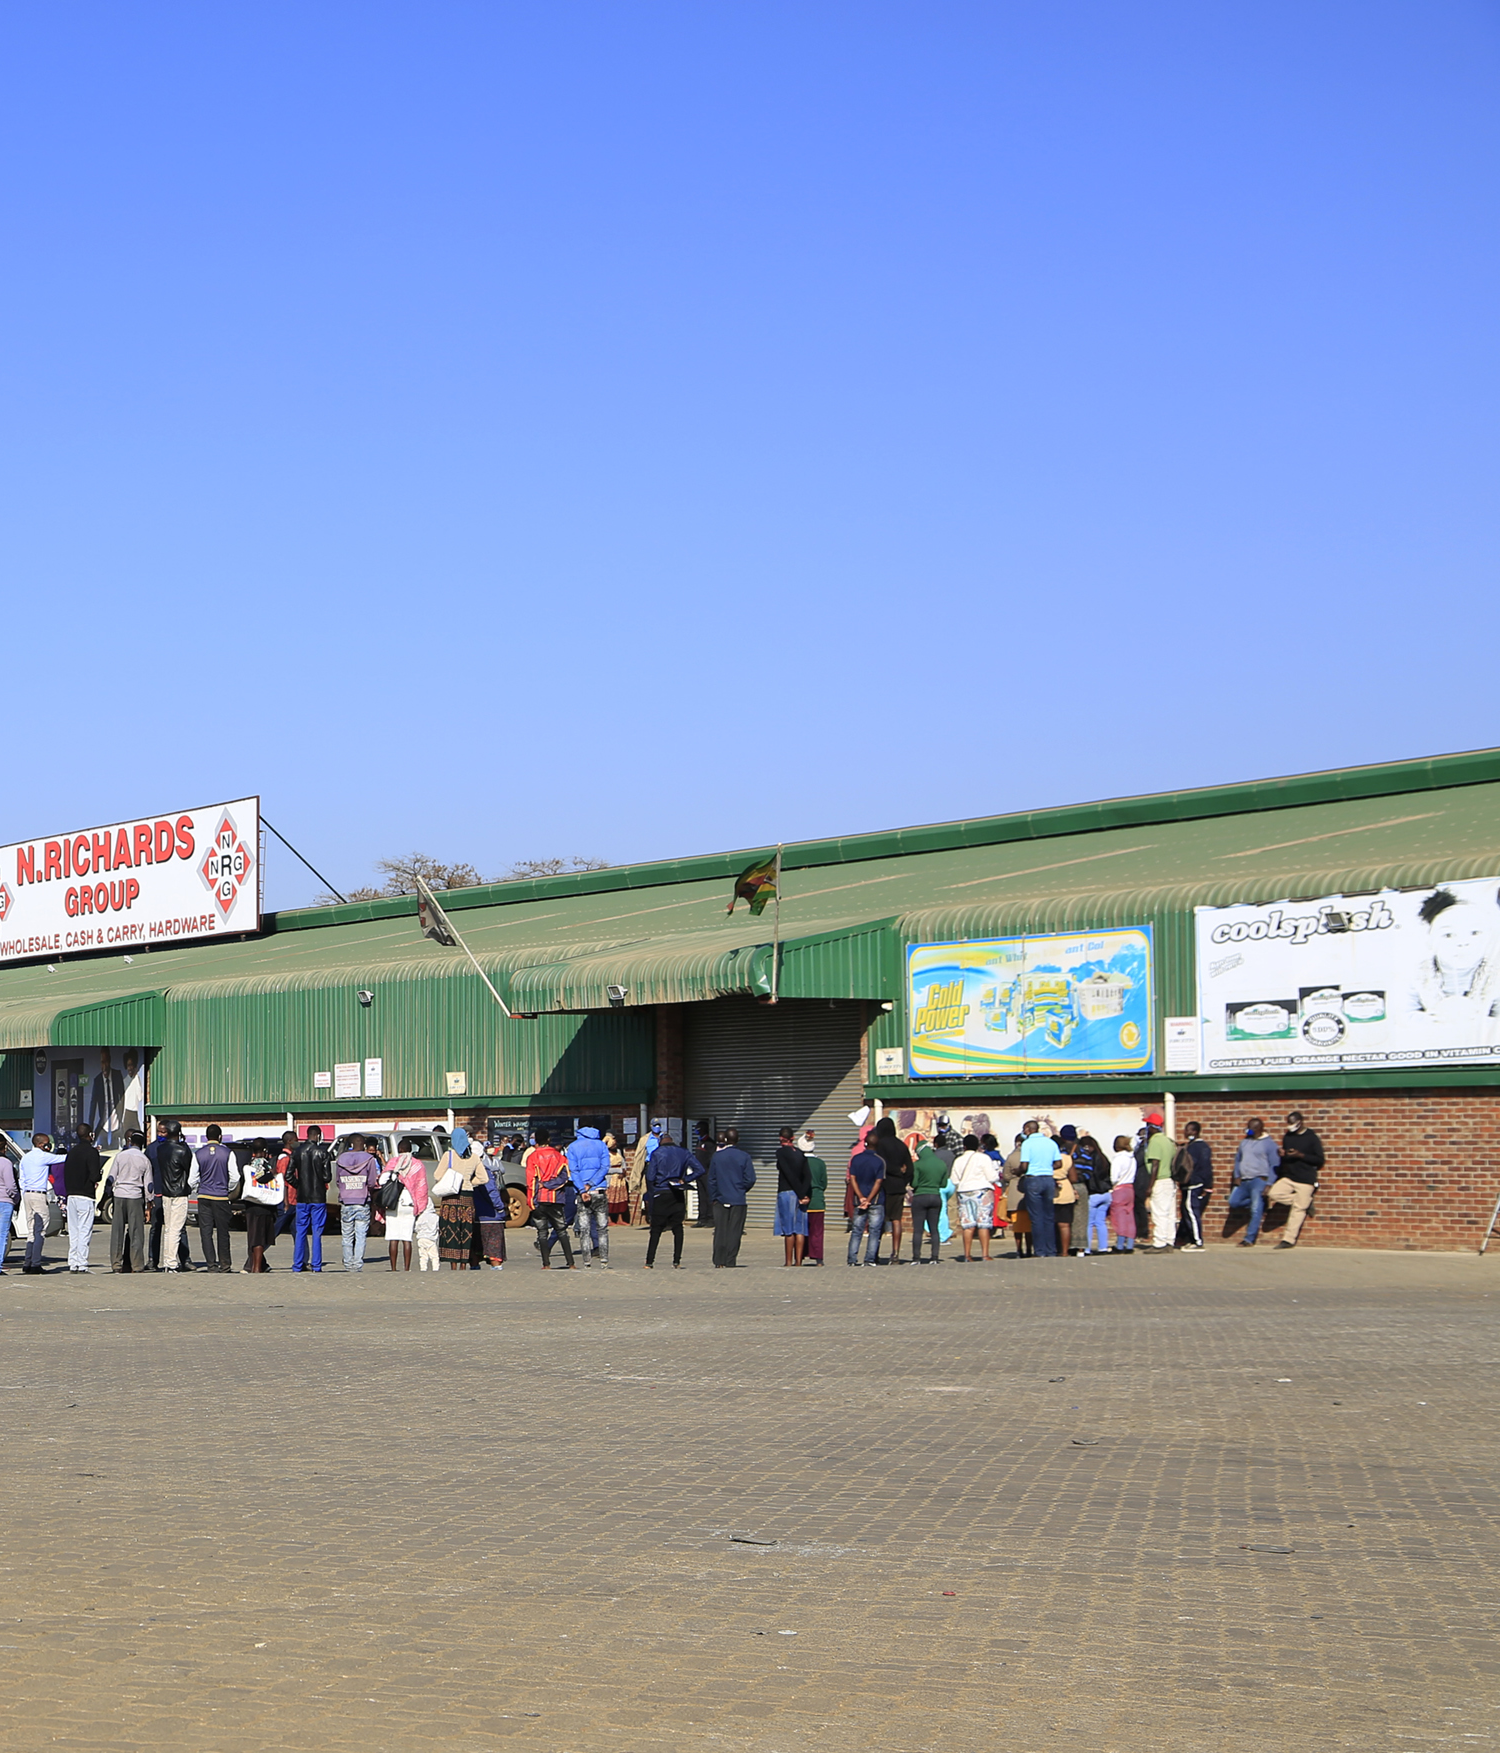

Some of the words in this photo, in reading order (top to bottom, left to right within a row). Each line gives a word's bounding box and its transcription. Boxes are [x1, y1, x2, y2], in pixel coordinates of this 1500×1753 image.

[17, 815, 195, 886] N.RICHARDS
[65, 878, 140, 917] GROUP
[0, 933, 62, 956] WHOLESALE,
[66, 928, 93, 948] CASH
[97, 928, 103, 944] &
[107, 922, 146, 944] CARRY,
[149, 913, 215, 938] HARDWARE
[1211, 900, 1394, 945] coolsplsh
[927, 979, 964, 1010] Cold
[914, 1004, 970, 1035] Power
[1210, 1057, 1262, 1068] CONTAINS
[1293, 1054, 1340, 1064] ORANGE
[1342, 1052, 1387, 1062] NECTAR
[1388, 1050, 1422, 1060] GOOD
[1424, 1049, 1439, 1058] IN
[1441, 1046, 1491, 1058] VITAMIN
